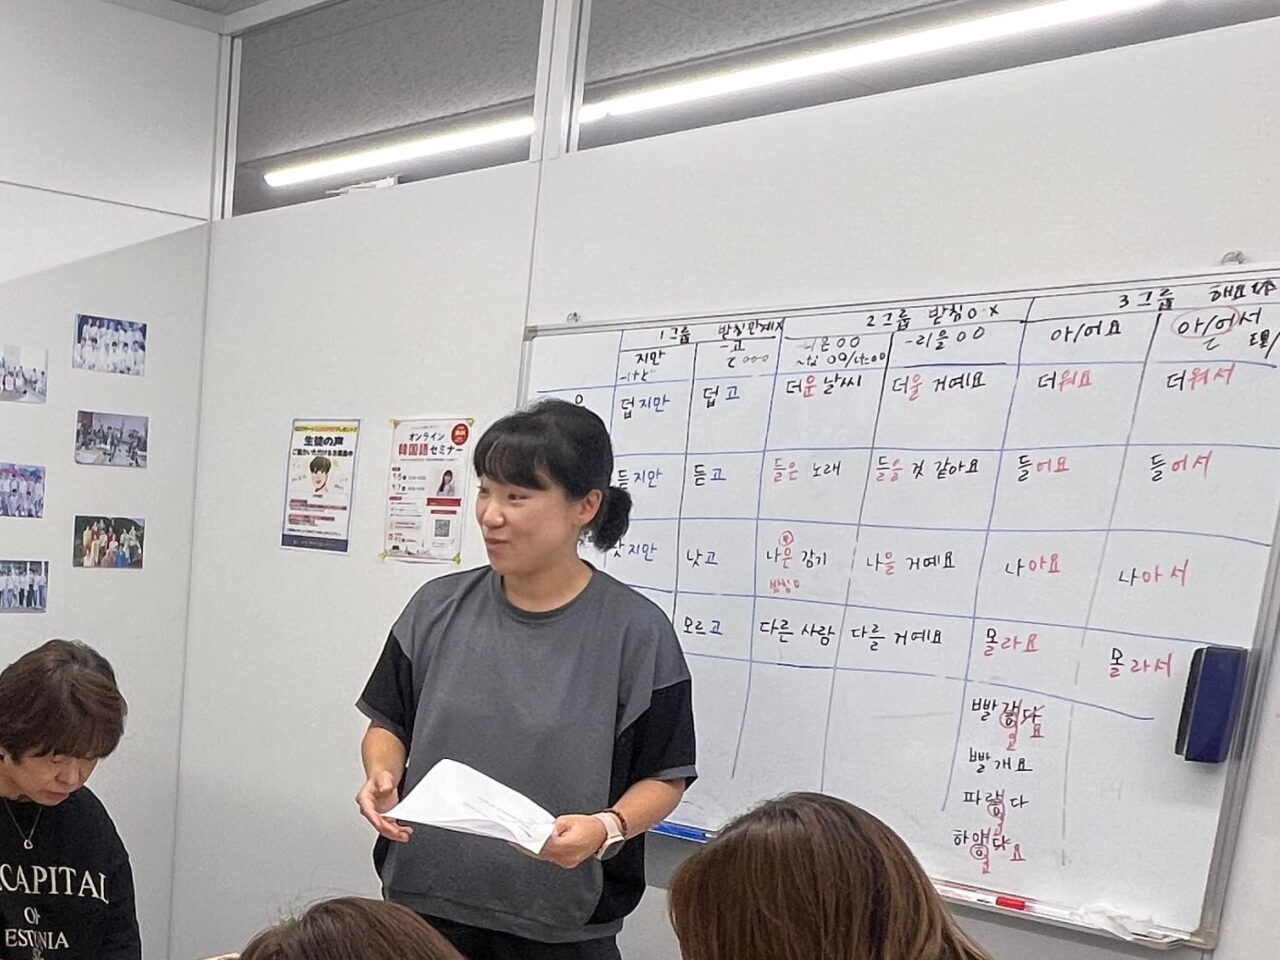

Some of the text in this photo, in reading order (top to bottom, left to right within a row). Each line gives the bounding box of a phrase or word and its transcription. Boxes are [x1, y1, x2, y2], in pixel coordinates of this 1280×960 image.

[786, 373, 862, 398] 더운 날씨
[933, 371, 986, 391] 거예요
[409, 431, 445, 441] オンライン
[812, 460, 841, 478] 노래
[801, 549, 828, 569] 감기
[906, 551, 956, 571] 거예요
[1005, 553, 1062, 577] 나아요
[1119, 559, 1190, 587] 나아서
[760, 618, 794, 643] 다른
[894, 629, 943, 646] 거예요
